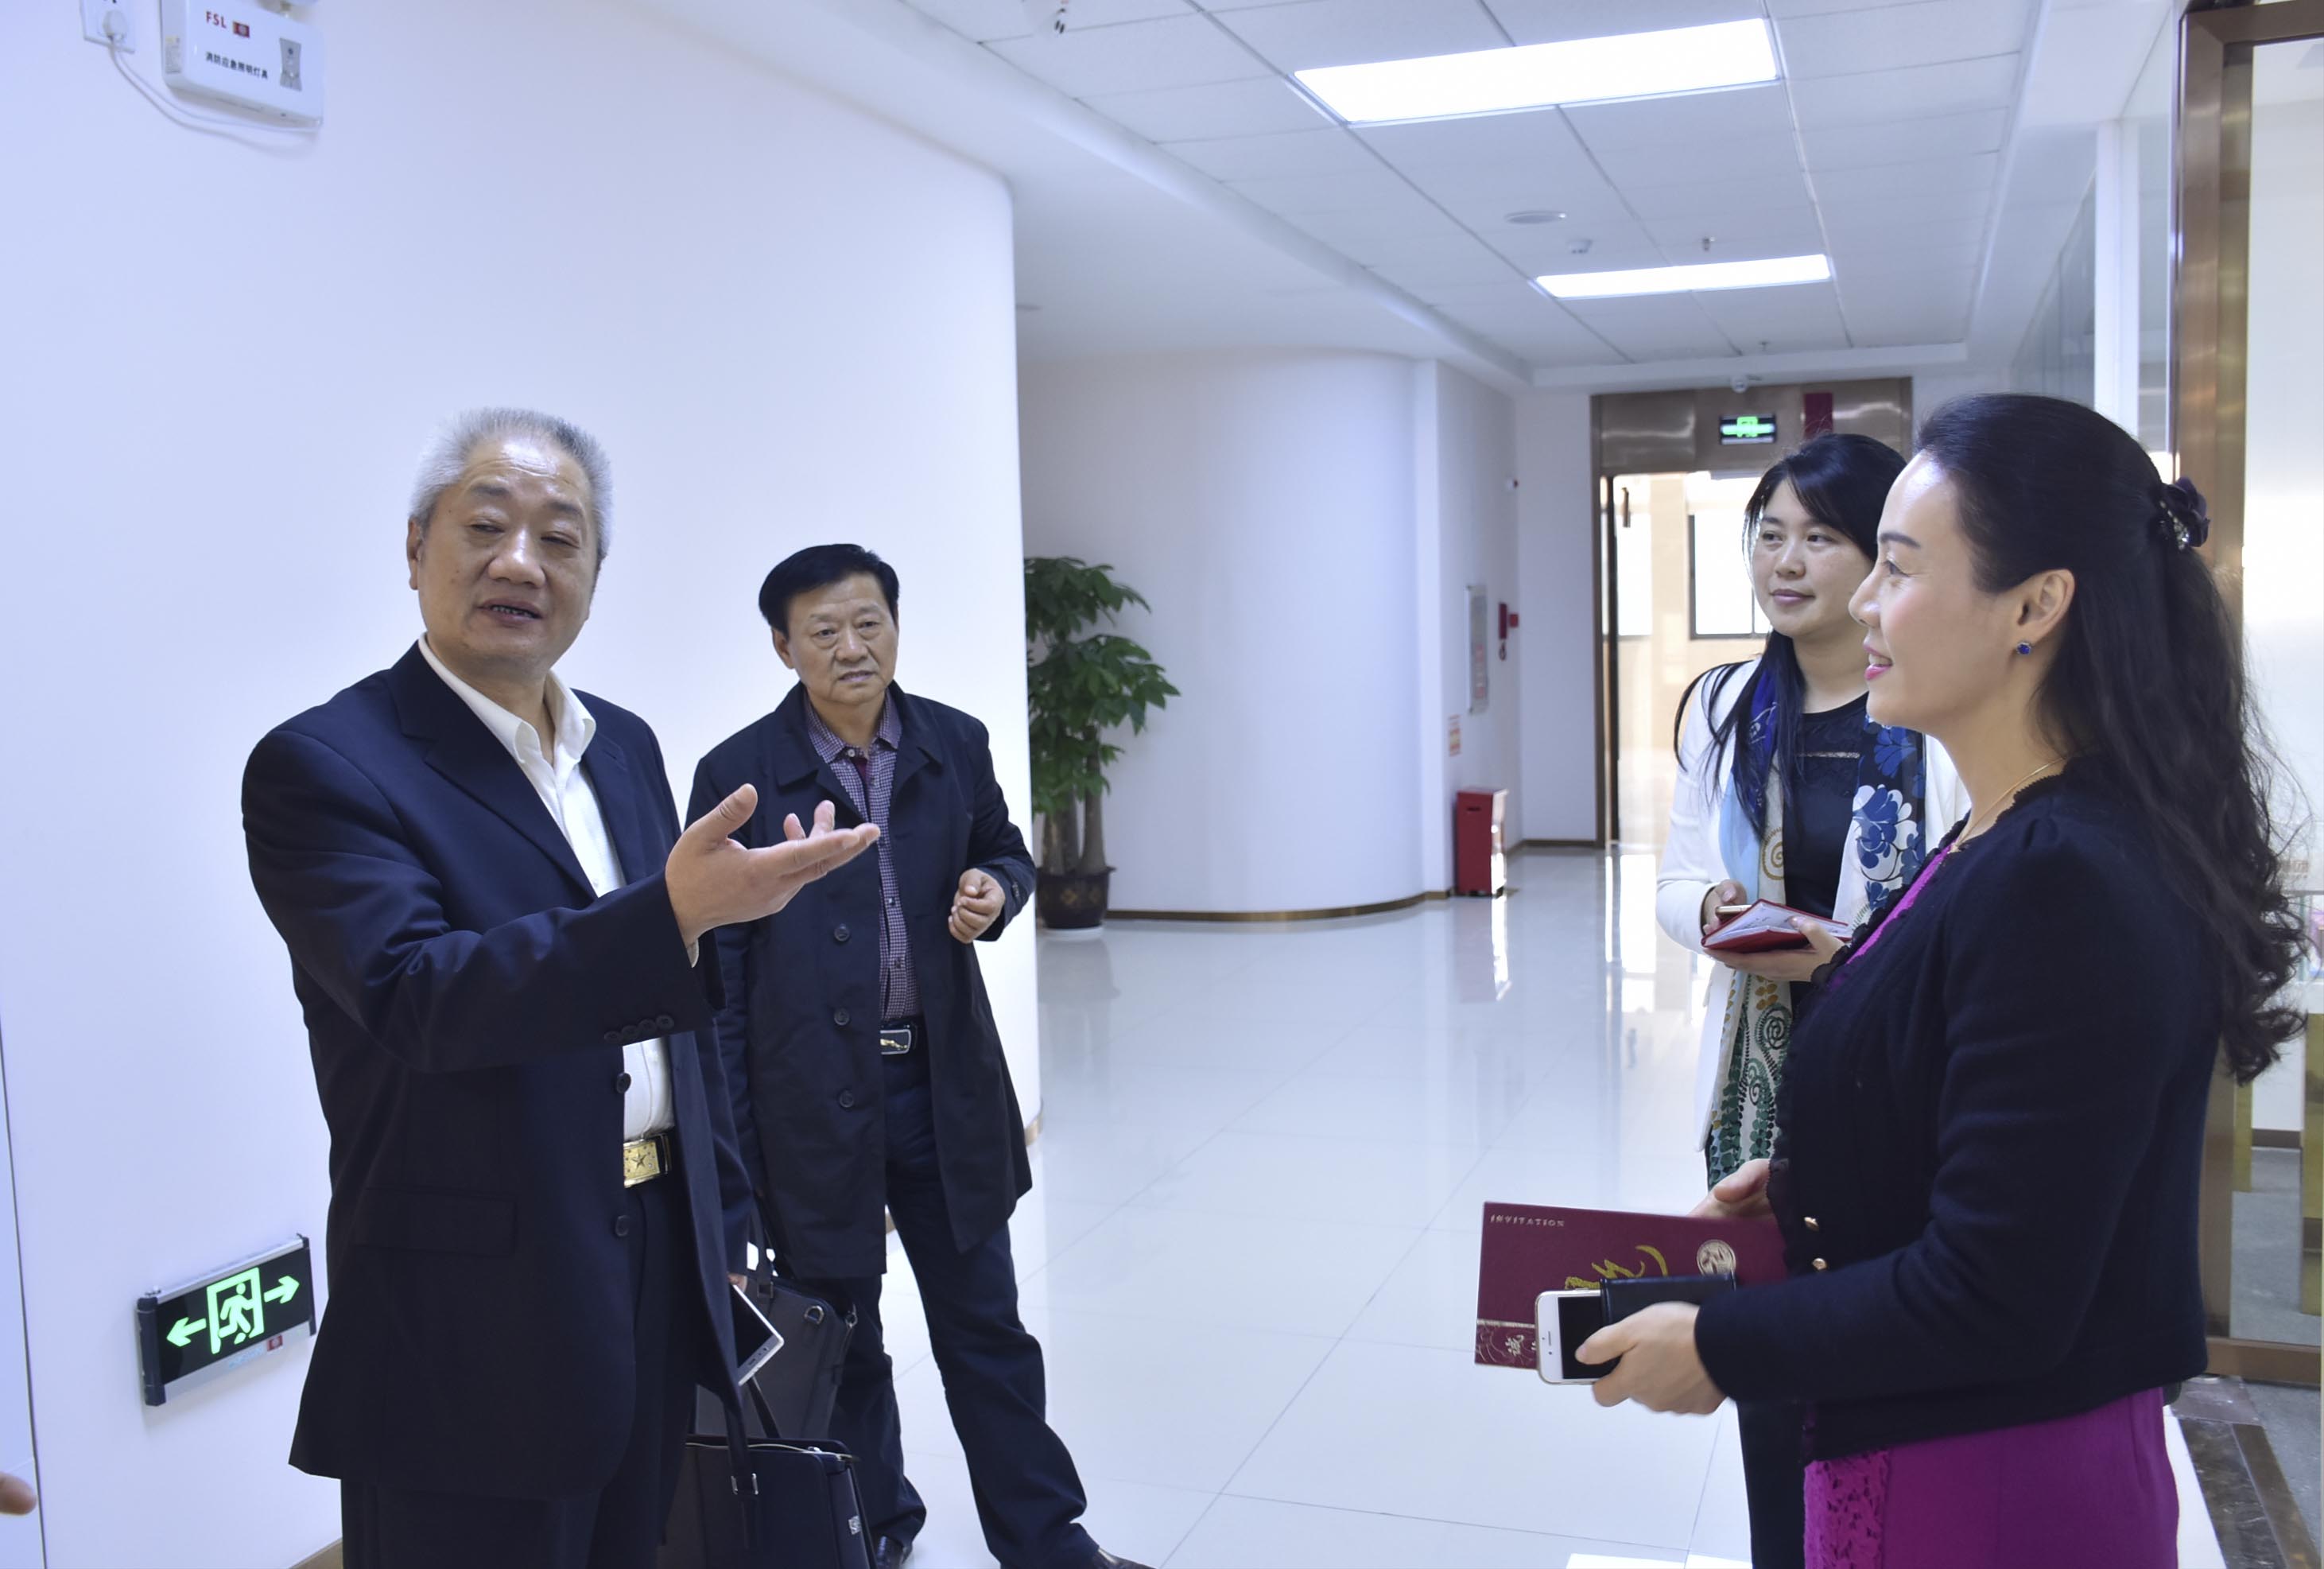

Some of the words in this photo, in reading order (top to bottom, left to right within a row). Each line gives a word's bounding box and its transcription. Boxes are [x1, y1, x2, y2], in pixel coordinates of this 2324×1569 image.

[206, 10, 227, 29] FSL
[206, 52, 269, 79] 消防应急照明灯具
[1490, 1214, 1565, 1228] INVITATION
